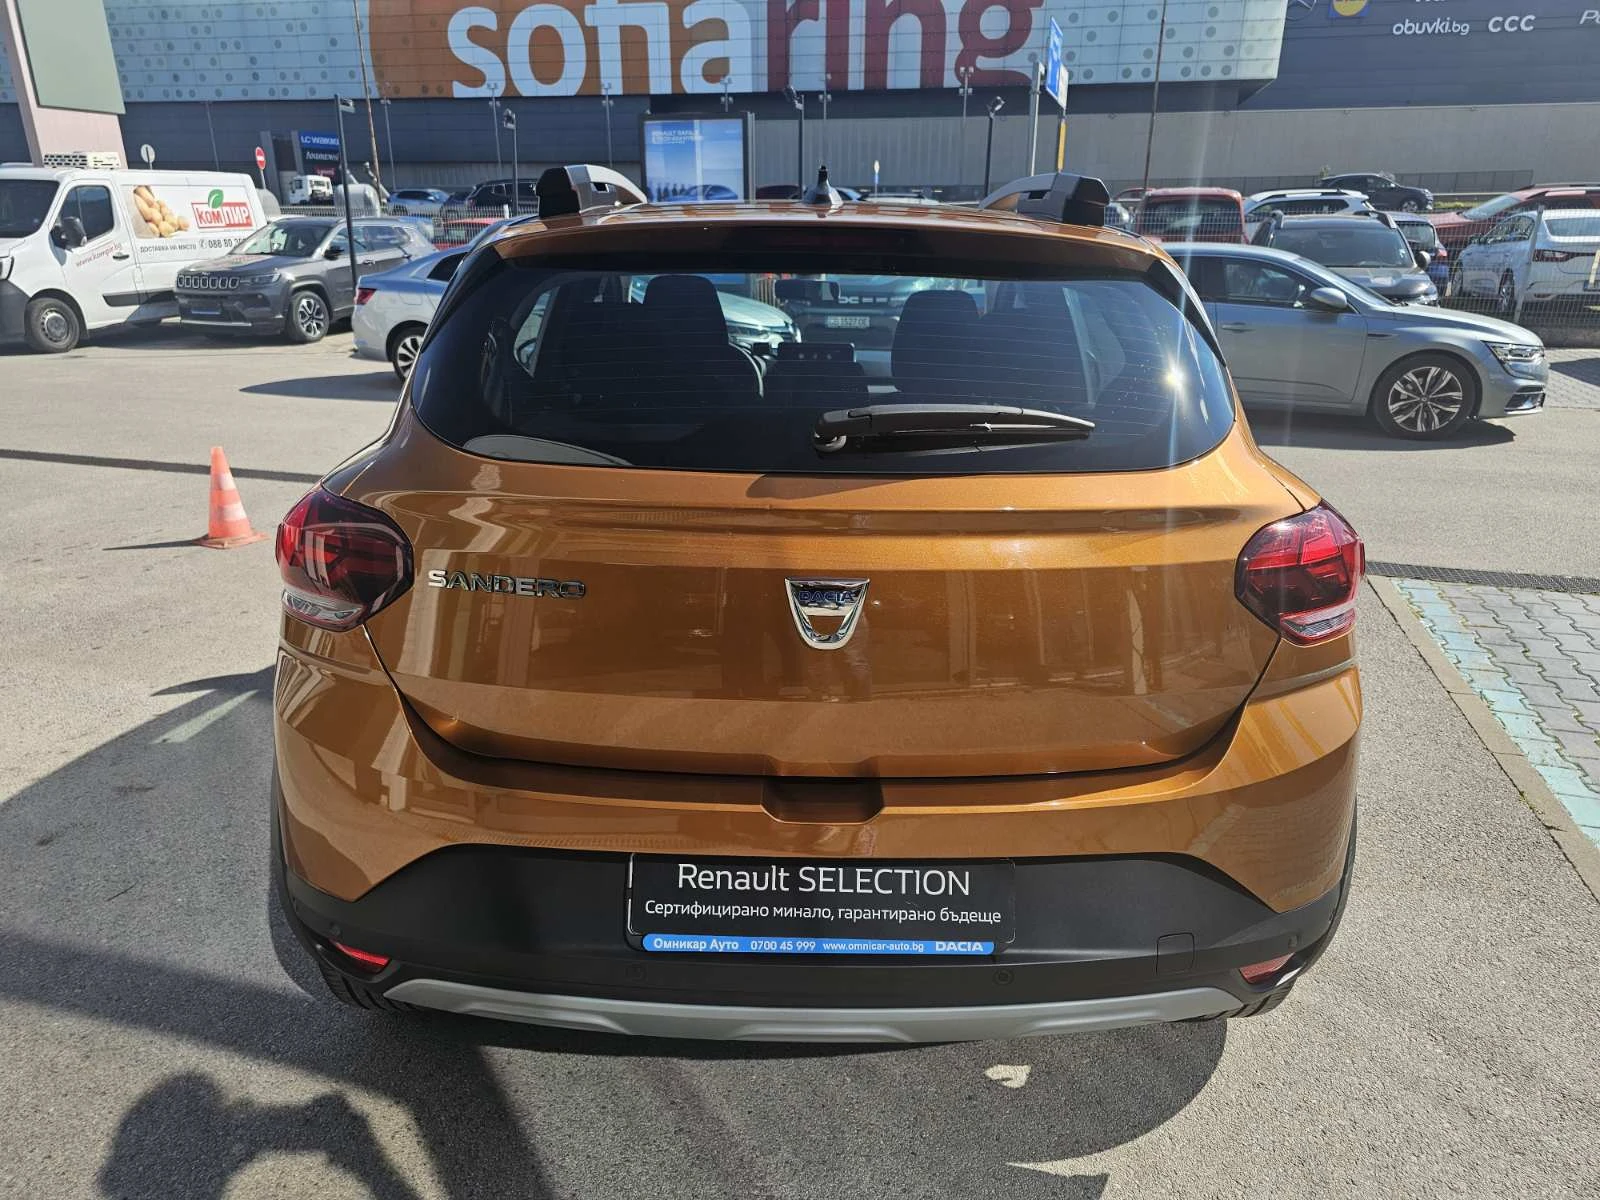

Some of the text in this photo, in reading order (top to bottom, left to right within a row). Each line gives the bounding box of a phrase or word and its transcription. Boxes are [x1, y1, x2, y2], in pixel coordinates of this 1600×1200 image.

[1392, 17, 1470, 35] obuvki.bg
[1488, 14, 1536, 33] CCC
[427, 569, 585, 599] SANDERO
[799, 590, 853, 602] DACIA
[678, 863, 970, 896] Renault SELECTION
[645, 900, 1002, 925] Сертифицирано минало, гарантирано бъдеще
[653, 937, 739, 951] Омникар Ауто
[750, 940, 816, 952] 0700 45 999
[822, 942, 925, 953] www.omnicar-auto.bg
[935, 941, 984, 953] DACIA
